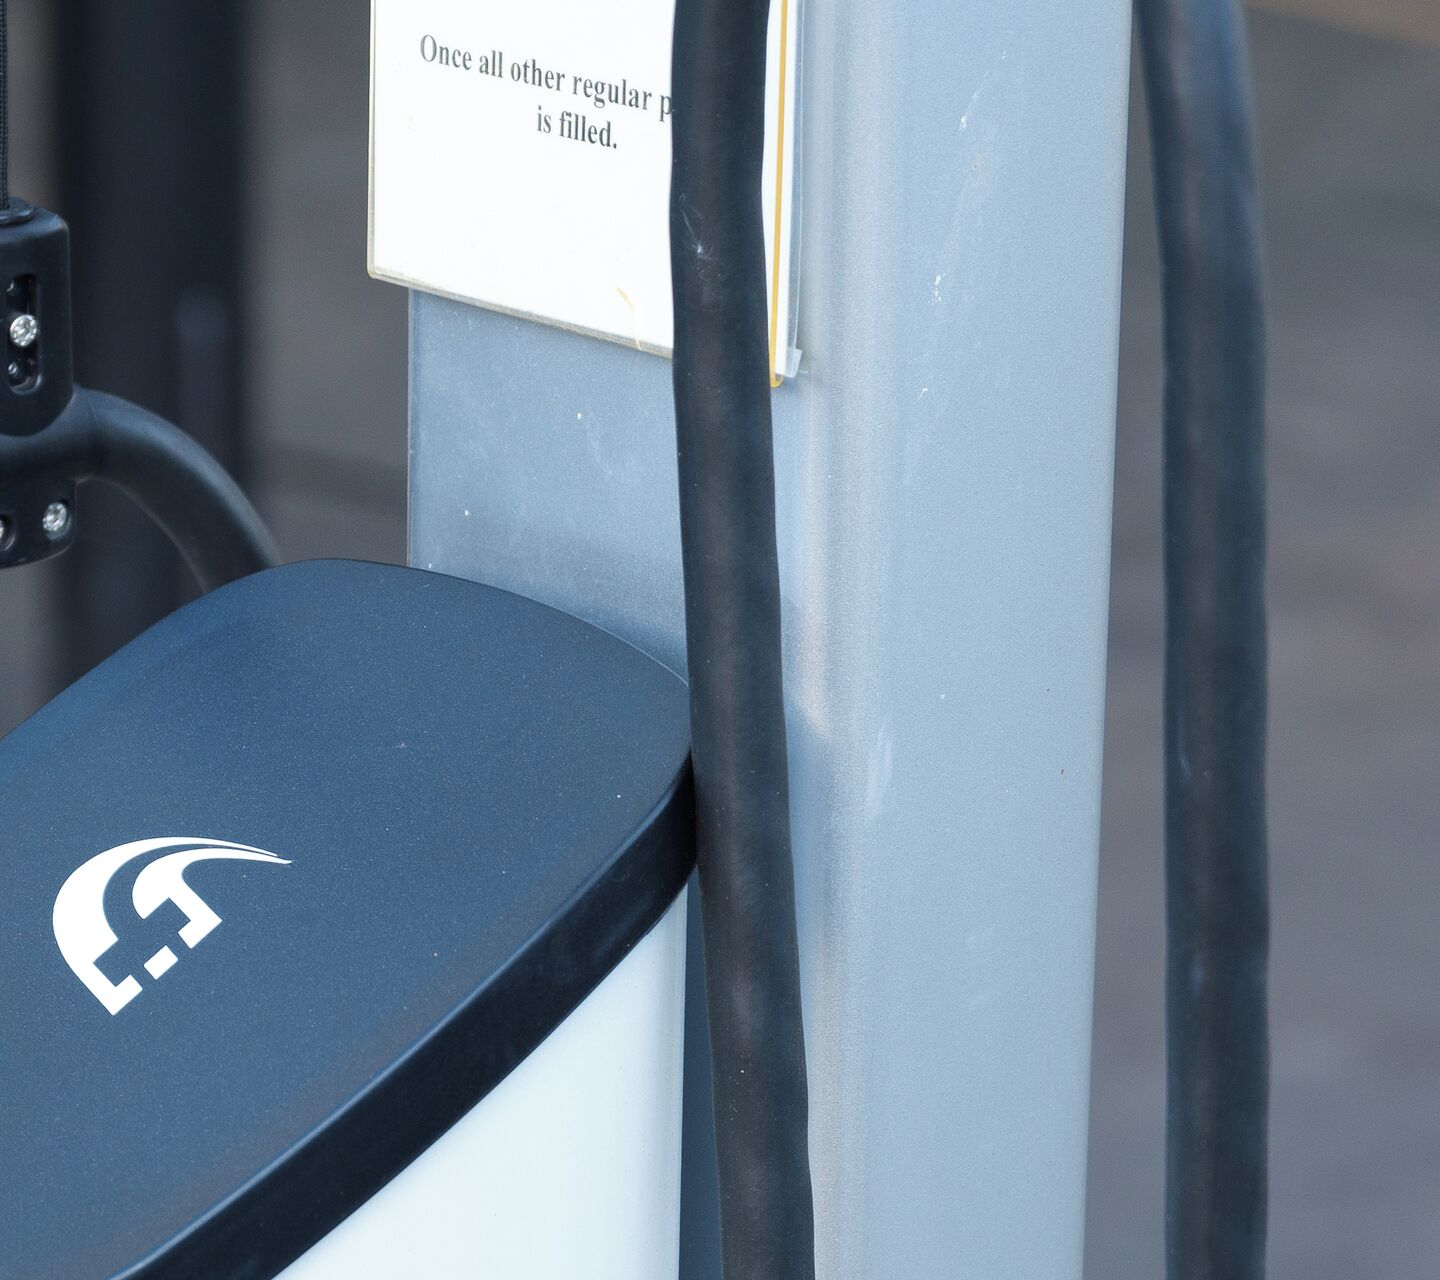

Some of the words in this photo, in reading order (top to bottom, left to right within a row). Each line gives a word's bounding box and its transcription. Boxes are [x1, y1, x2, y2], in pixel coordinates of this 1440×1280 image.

[421, 35, 471, 70] Once
[480, 51, 502, 78] all
[511, 59, 565, 90] other
[573, 77, 652, 110] regular
[538, 106, 551, 133] is
[560, 111, 616, 149] filled.
